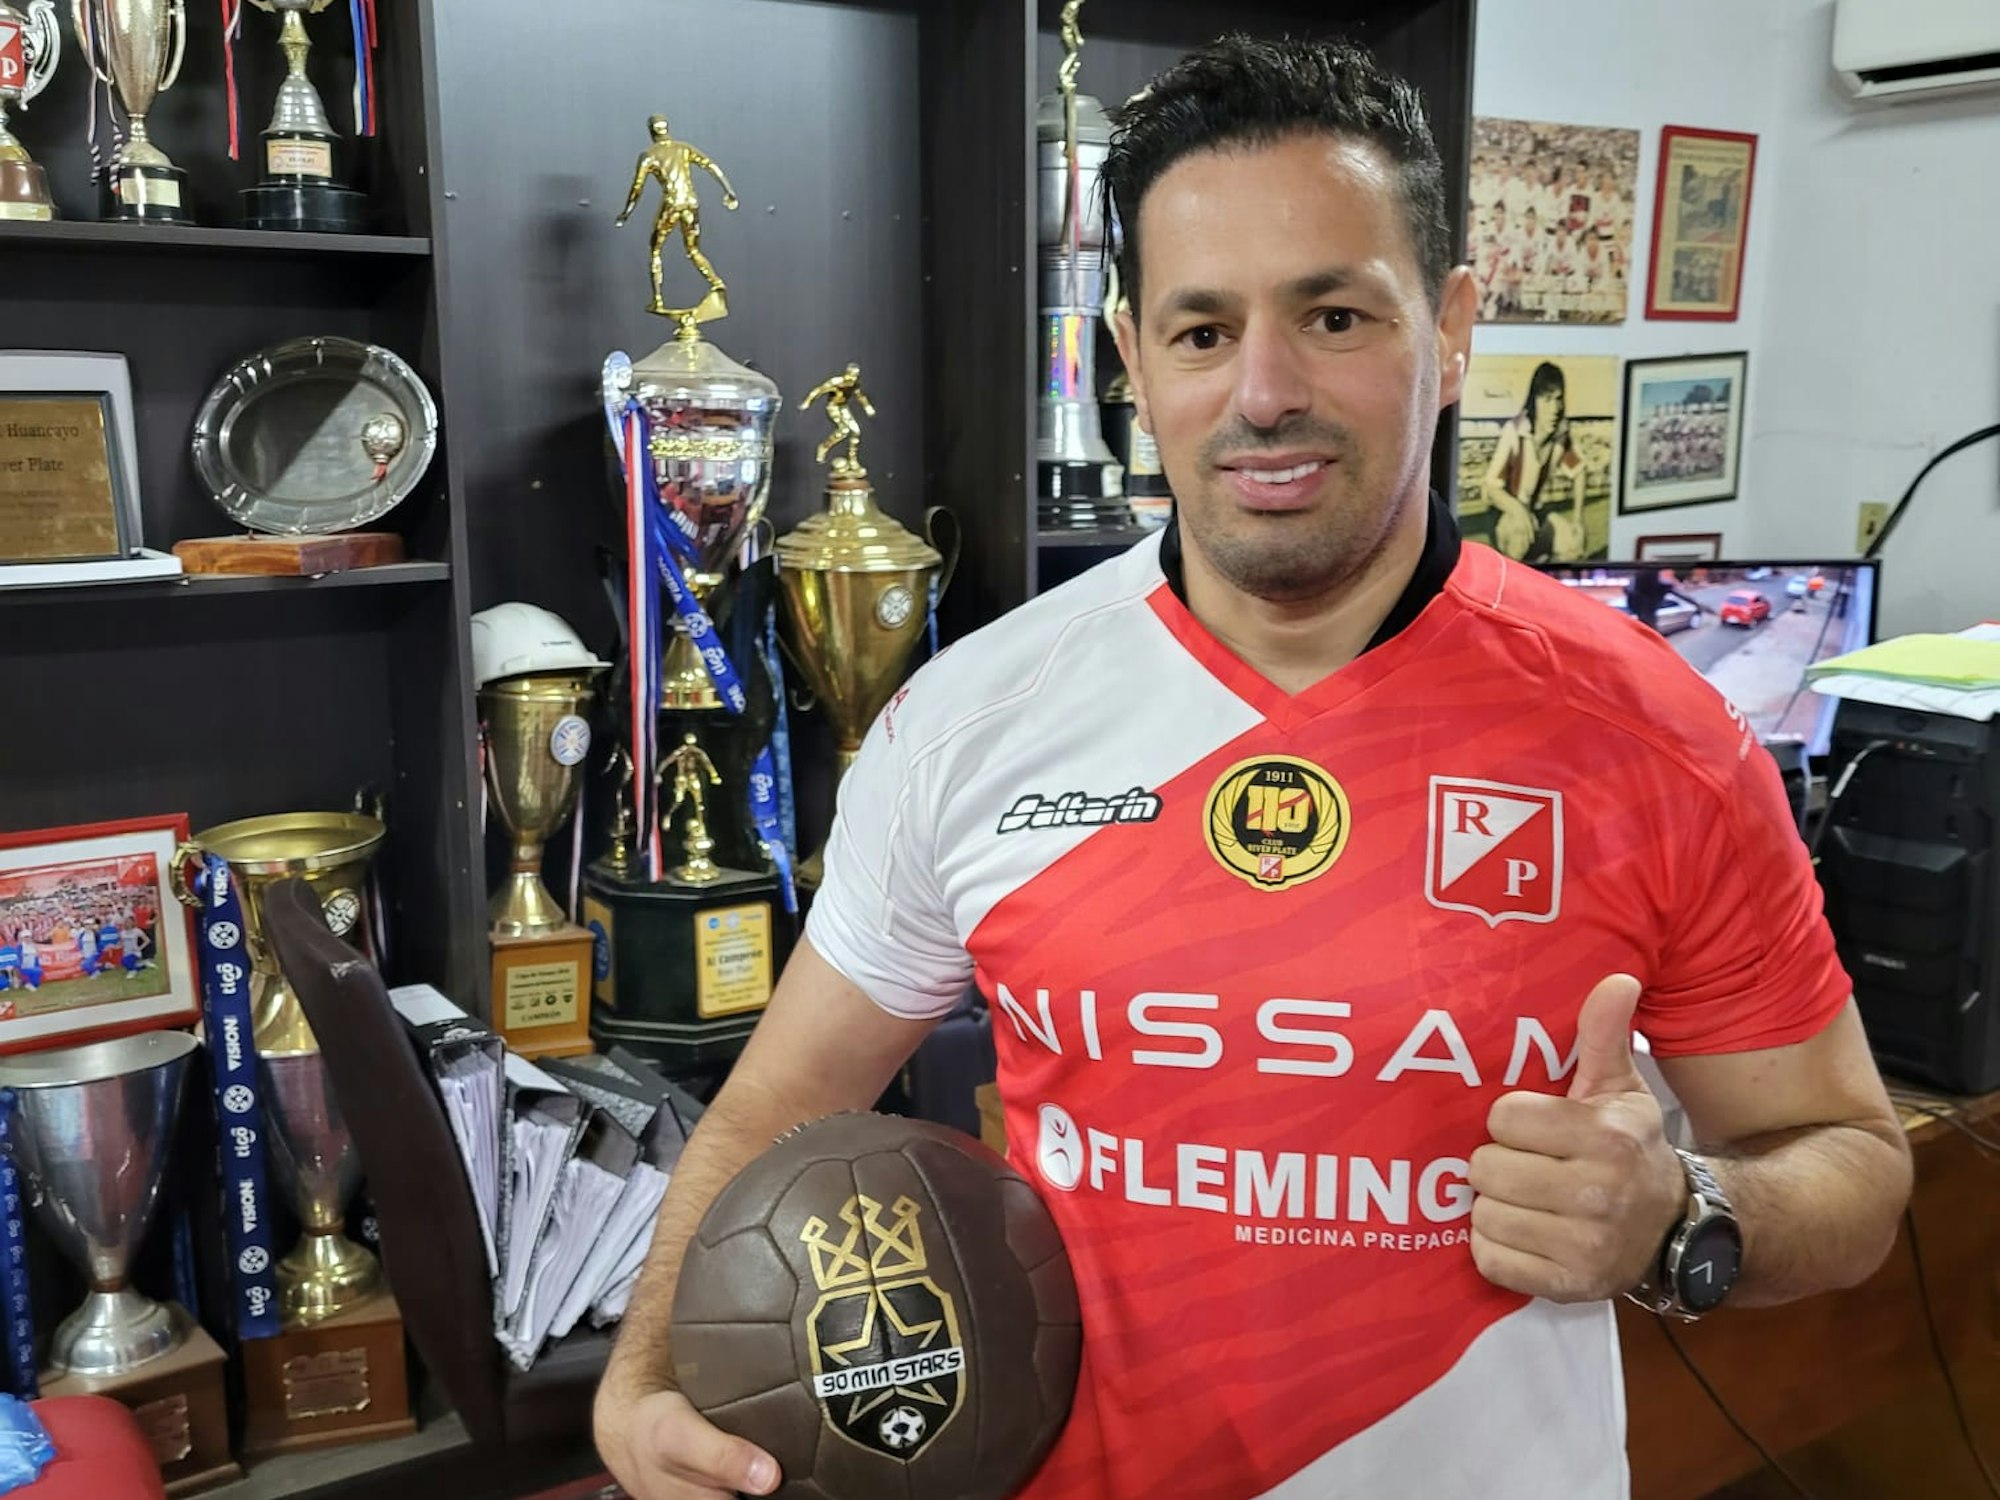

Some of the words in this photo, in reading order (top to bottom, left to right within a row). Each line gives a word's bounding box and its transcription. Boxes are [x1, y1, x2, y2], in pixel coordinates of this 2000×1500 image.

[0, 460, 24, 472] ver
[1265, 770, 1294, 783] 1911
[1451, 798, 1496, 837] R
[213, 866, 228, 908] VISIO
[1502, 857, 1539, 897] P
[223, 1014, 242, 1072] VISION
[996, 983, 1579, 1087] NISSAN
[1086, 1126, 1475, 1225] FLEMING
[239, 1177, 257, 1234] VISION
[1235, 1224, 1356, 1247] MEDICINA
[1363, 1228, 1471, 1251] PREPAGA
[823, 1375, 848, 1393] 90
[894, 1351, 961, 1381] STARS
